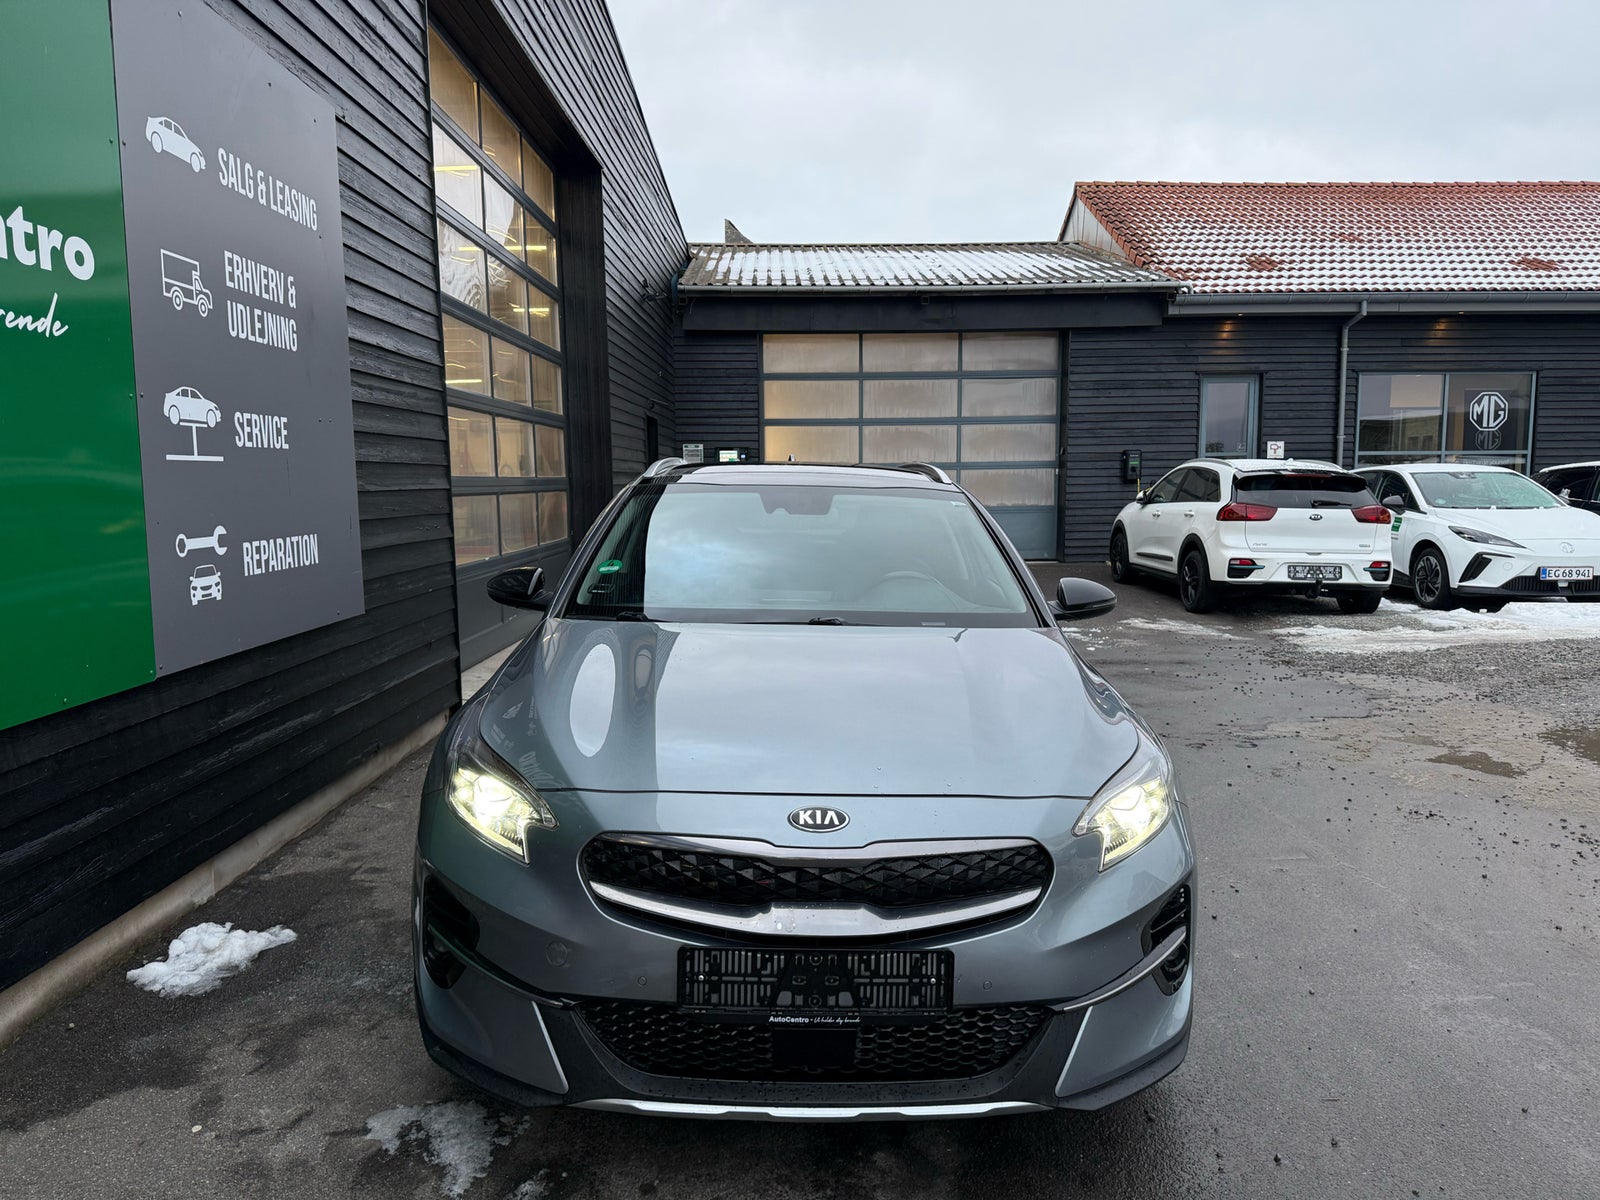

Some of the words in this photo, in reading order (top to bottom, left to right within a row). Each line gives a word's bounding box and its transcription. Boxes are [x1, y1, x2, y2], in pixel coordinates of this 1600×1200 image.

[217, 147, 254, 199] SALG
[257, 170, 267, 206] &
[269, 175, 318, 231] LEASING
[224, 250, 284, 305] ERHVERV
[287, 275, 297, 309] &
[227, 300, 298, 352] UDLEJNING
[234, 411, 289, 449] SERVICE
[1472, 394, 1506, 428] MG
[242, 533, 319, 577] REPARATION
[1547, 569, 1560, 578] EG
[1562, 569, 1573, 578] 68
[1575, 569, 1591, 578] 941
[799, 809, 840, 825] KIA
